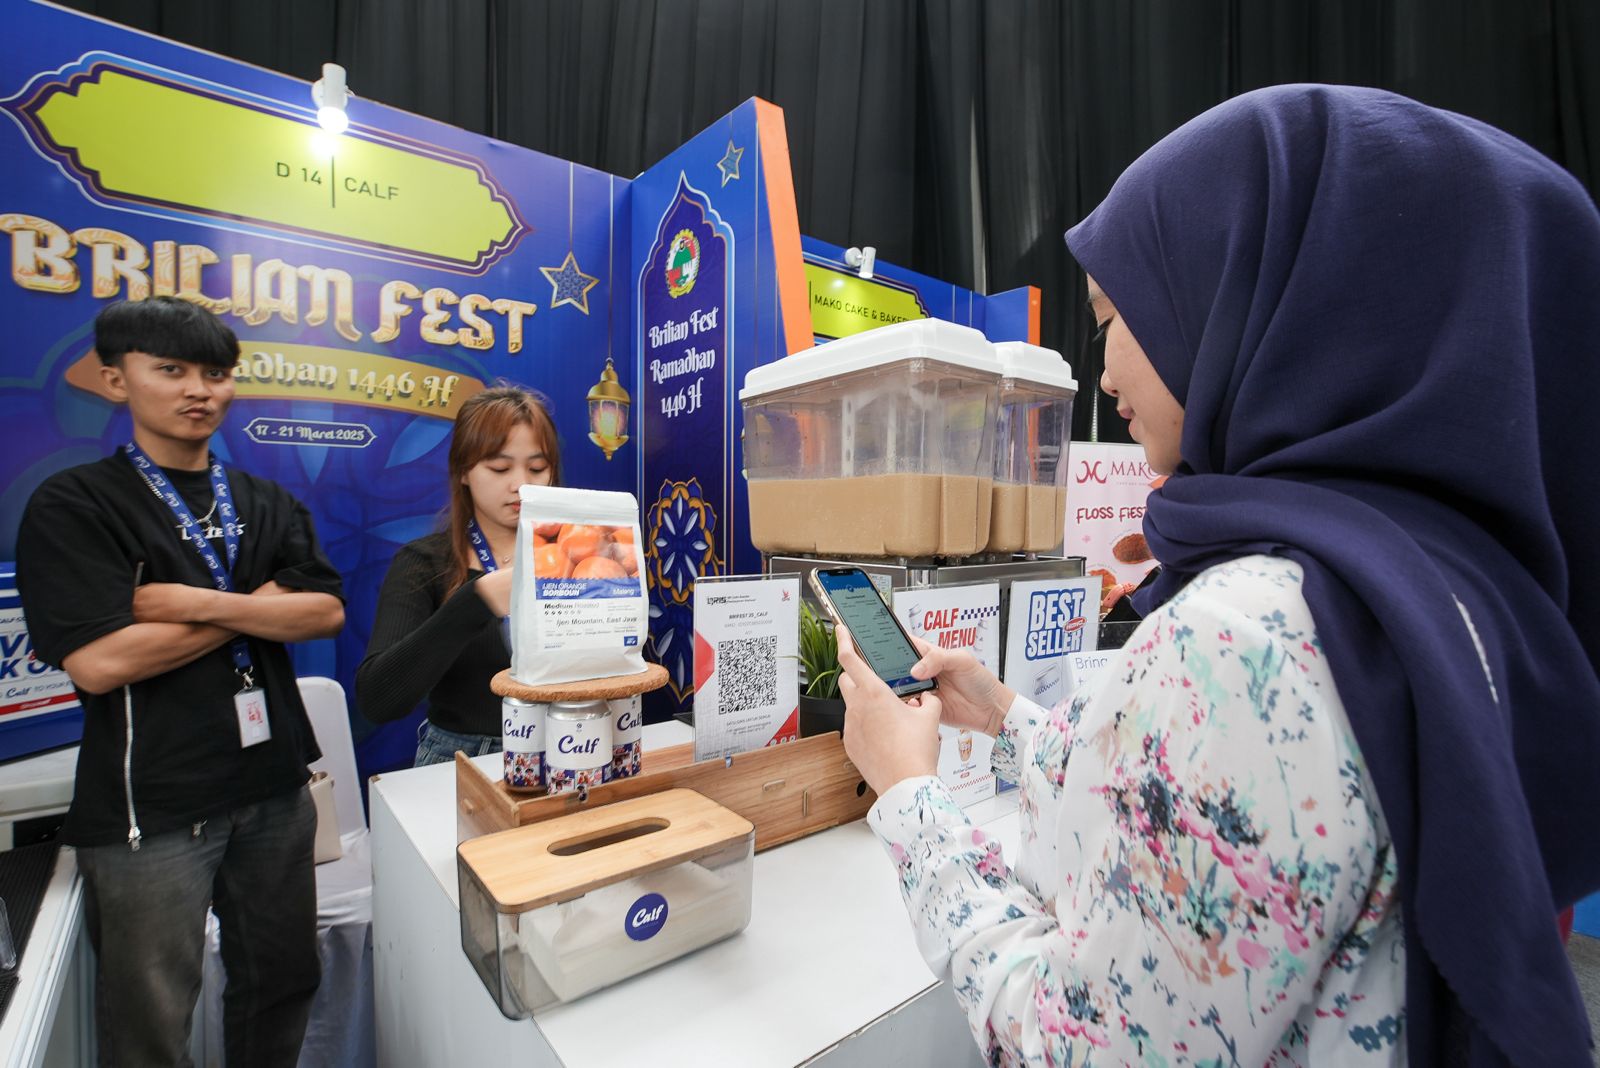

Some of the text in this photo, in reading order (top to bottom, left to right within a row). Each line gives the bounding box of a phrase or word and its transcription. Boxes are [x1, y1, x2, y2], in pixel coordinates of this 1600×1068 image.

[276, 162, 322, 185] D 14
[344, 177, 399, 200] CALF
[0, 213, 363, 342] BRILIAN
[371, 280, 537, 354] FEST
[814, 294, 842, 311] MAKO
[845, 302, 869, 318] CAKE
[871, 309, 878, 320] &
[648, 306, 719, 348] Brilian Fest
[650, 347, 716, 384] Ramadhan
[231, 351, 460, 407] adhan 1446 H
[661, 377, 704, 418] 1446 H
[255, 425, 269, 436] 17
[279, 425, 293, 437] 21
[336, 429, 365, 441] 2025
[1076, 506, 1114, 524] FLOSS
[923, 607, 960, 632] CALF
[1030, 588, 1086, 632] BEST
[938, 626, 977, 650] MENU
[1026, 628, 1083, 659] SELLER
[504, 718, 536, 739] Calf
[558, 735, 601, 754] Calf
[632, 904, 665, 928] Calf
